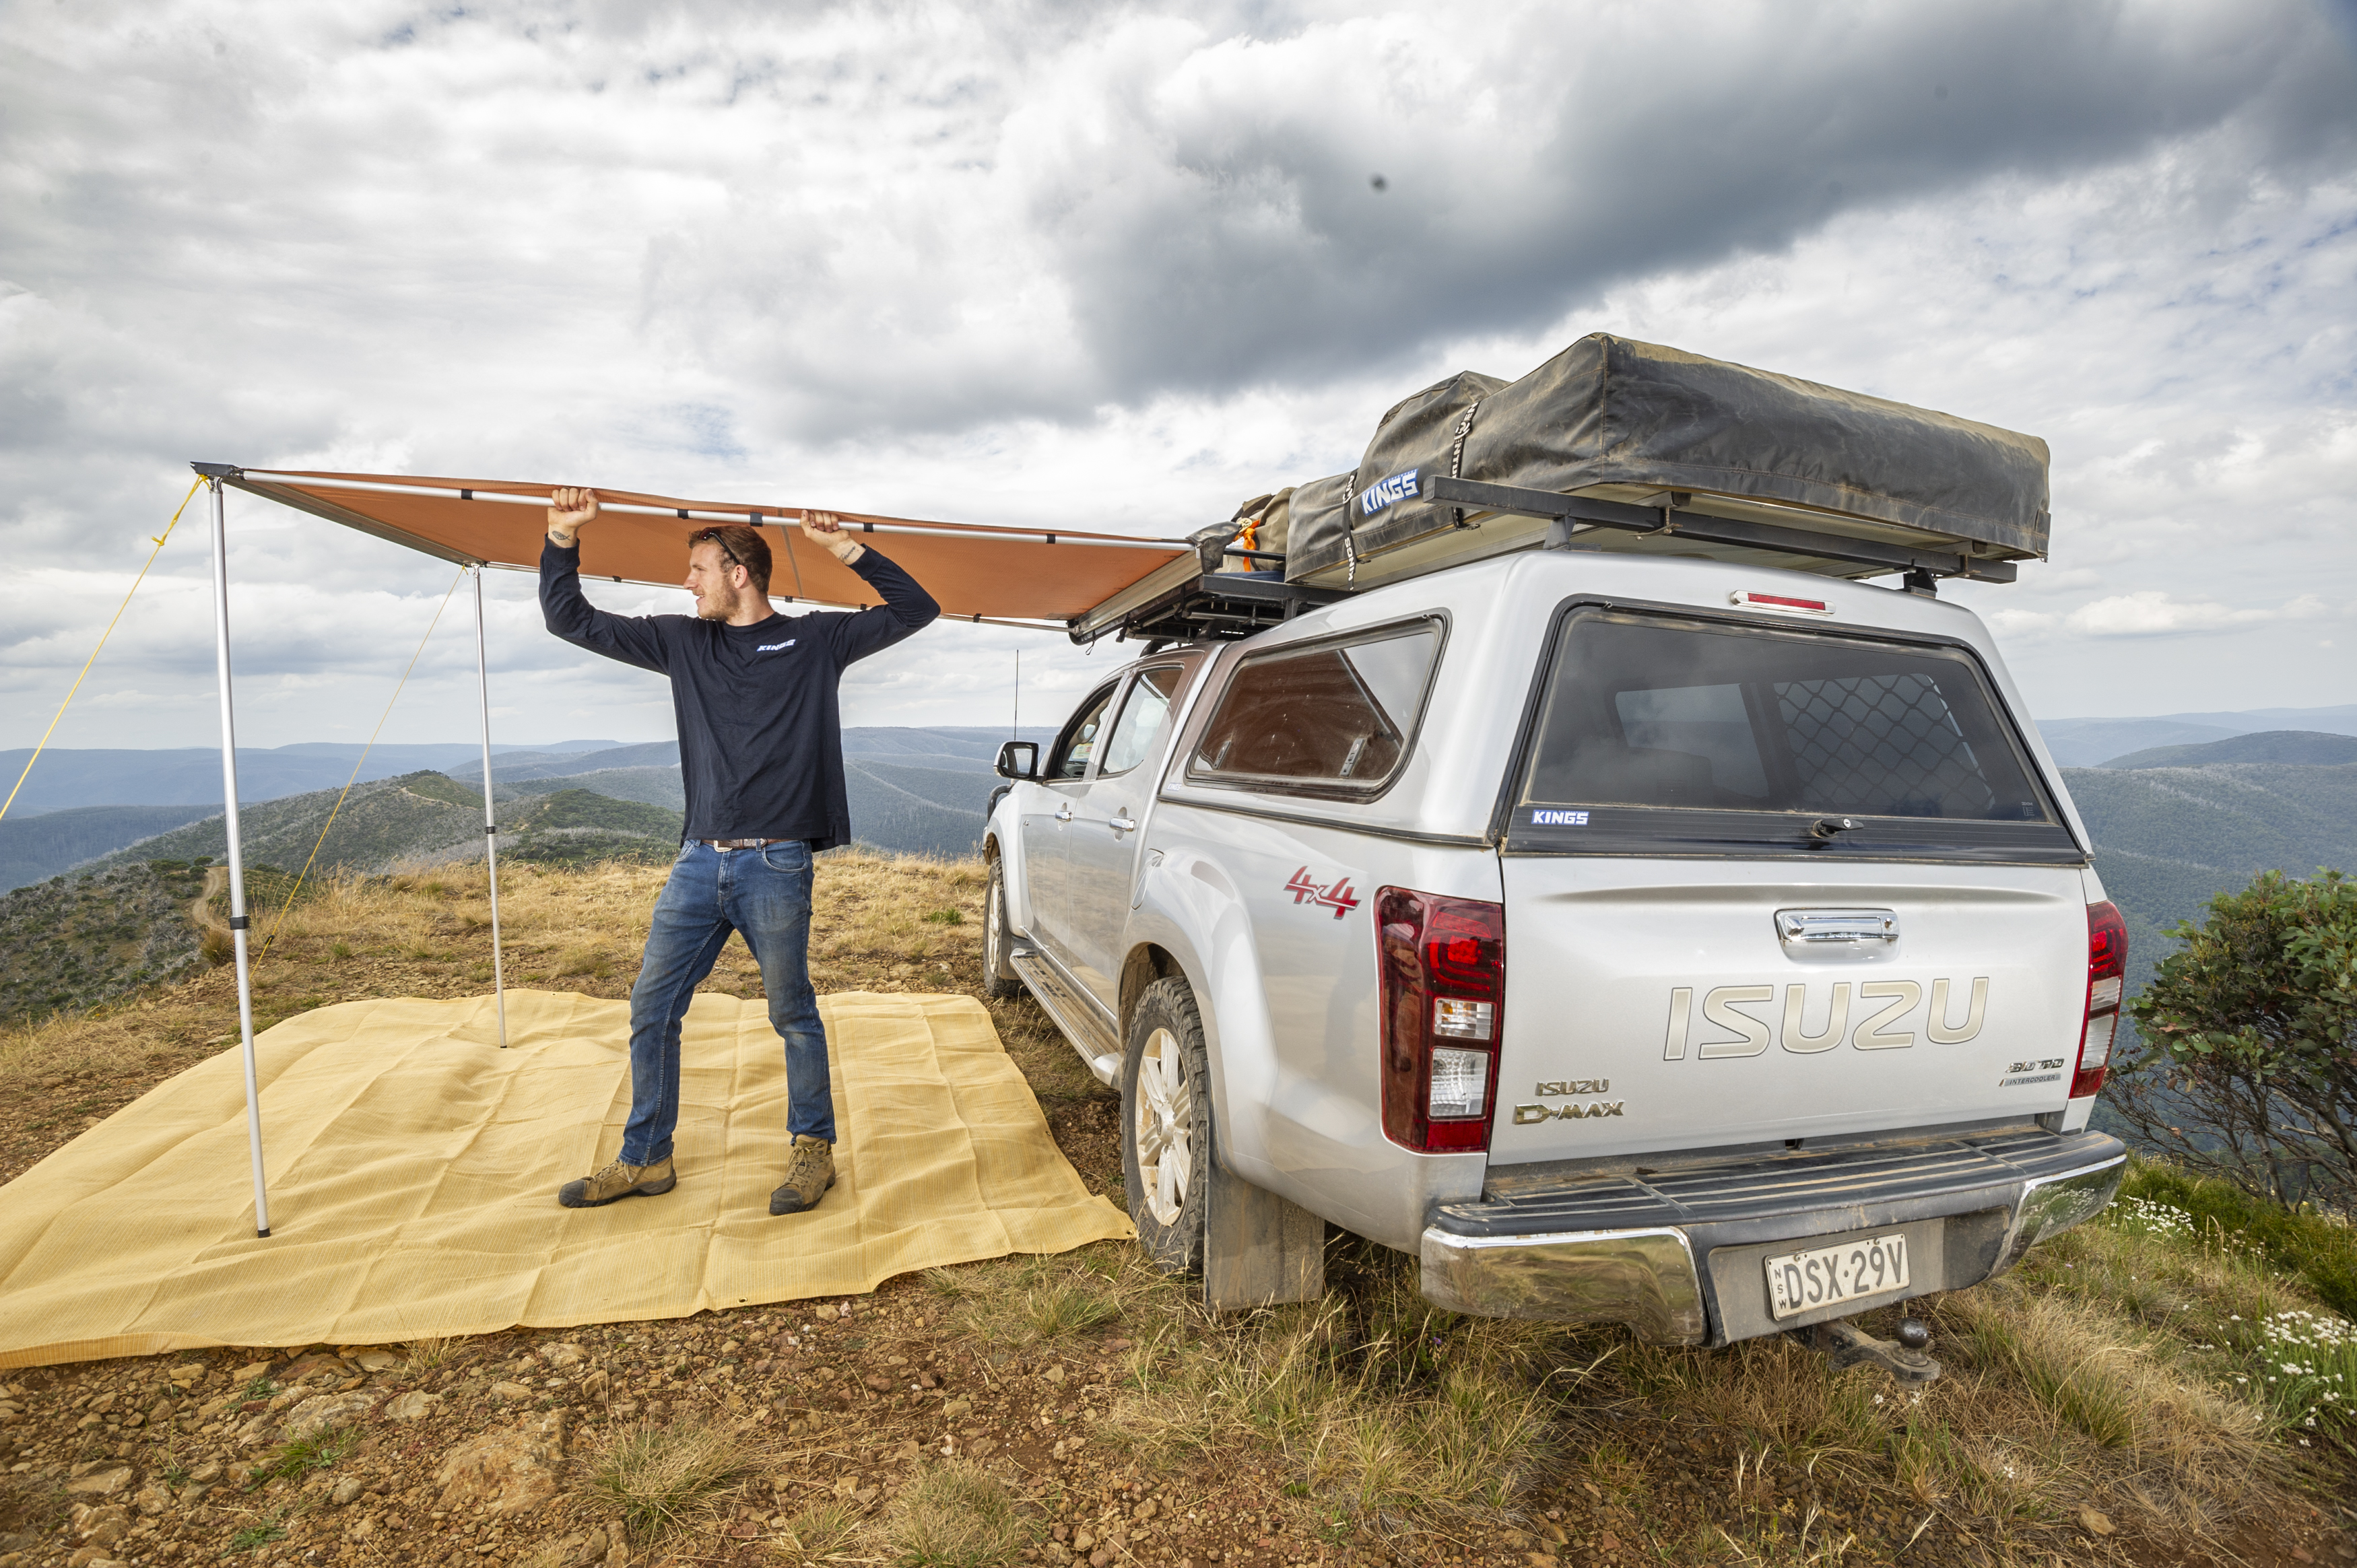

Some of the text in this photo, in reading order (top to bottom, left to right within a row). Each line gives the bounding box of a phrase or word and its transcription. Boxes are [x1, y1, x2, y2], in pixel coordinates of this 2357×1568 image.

[1362, 473, 1418, 514] KINGS
[1344, 537, 1354, 581] KINGS
[757, 639, 796, 652] KINGS
[1533, 811, 1588, 825] KINGS
[1663, 977, 1989, 1061] ISUZU
[1536, 1079, 1609, 1096] ISUZU
[2010, 1075, 2055, 1085] INTERCOOLER
[1515, 1099, 1625, 1125] D-MAX
